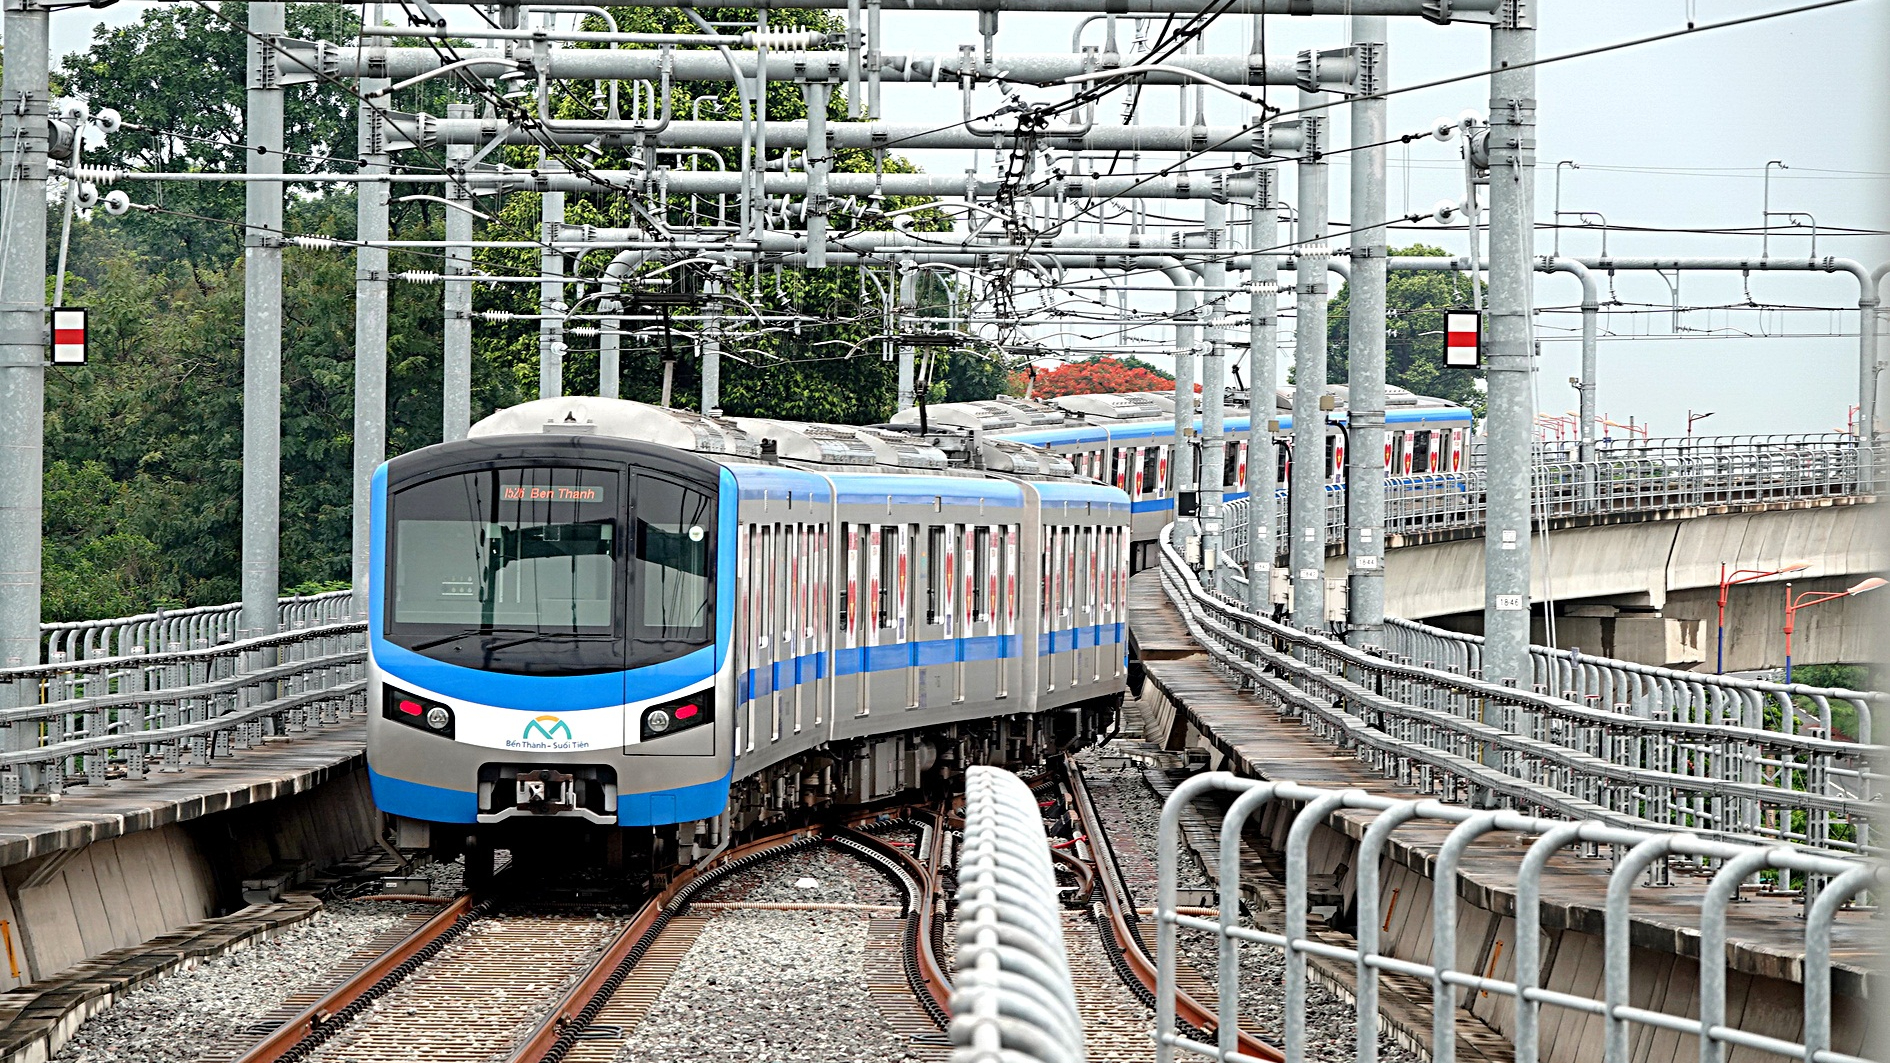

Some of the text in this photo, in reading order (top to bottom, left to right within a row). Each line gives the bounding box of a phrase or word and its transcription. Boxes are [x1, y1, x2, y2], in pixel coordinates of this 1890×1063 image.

[530, 488, 554, 499] Ben
[559, 488, 595, 500] Thanh
[1500, 598, 1519, 607] 1846
